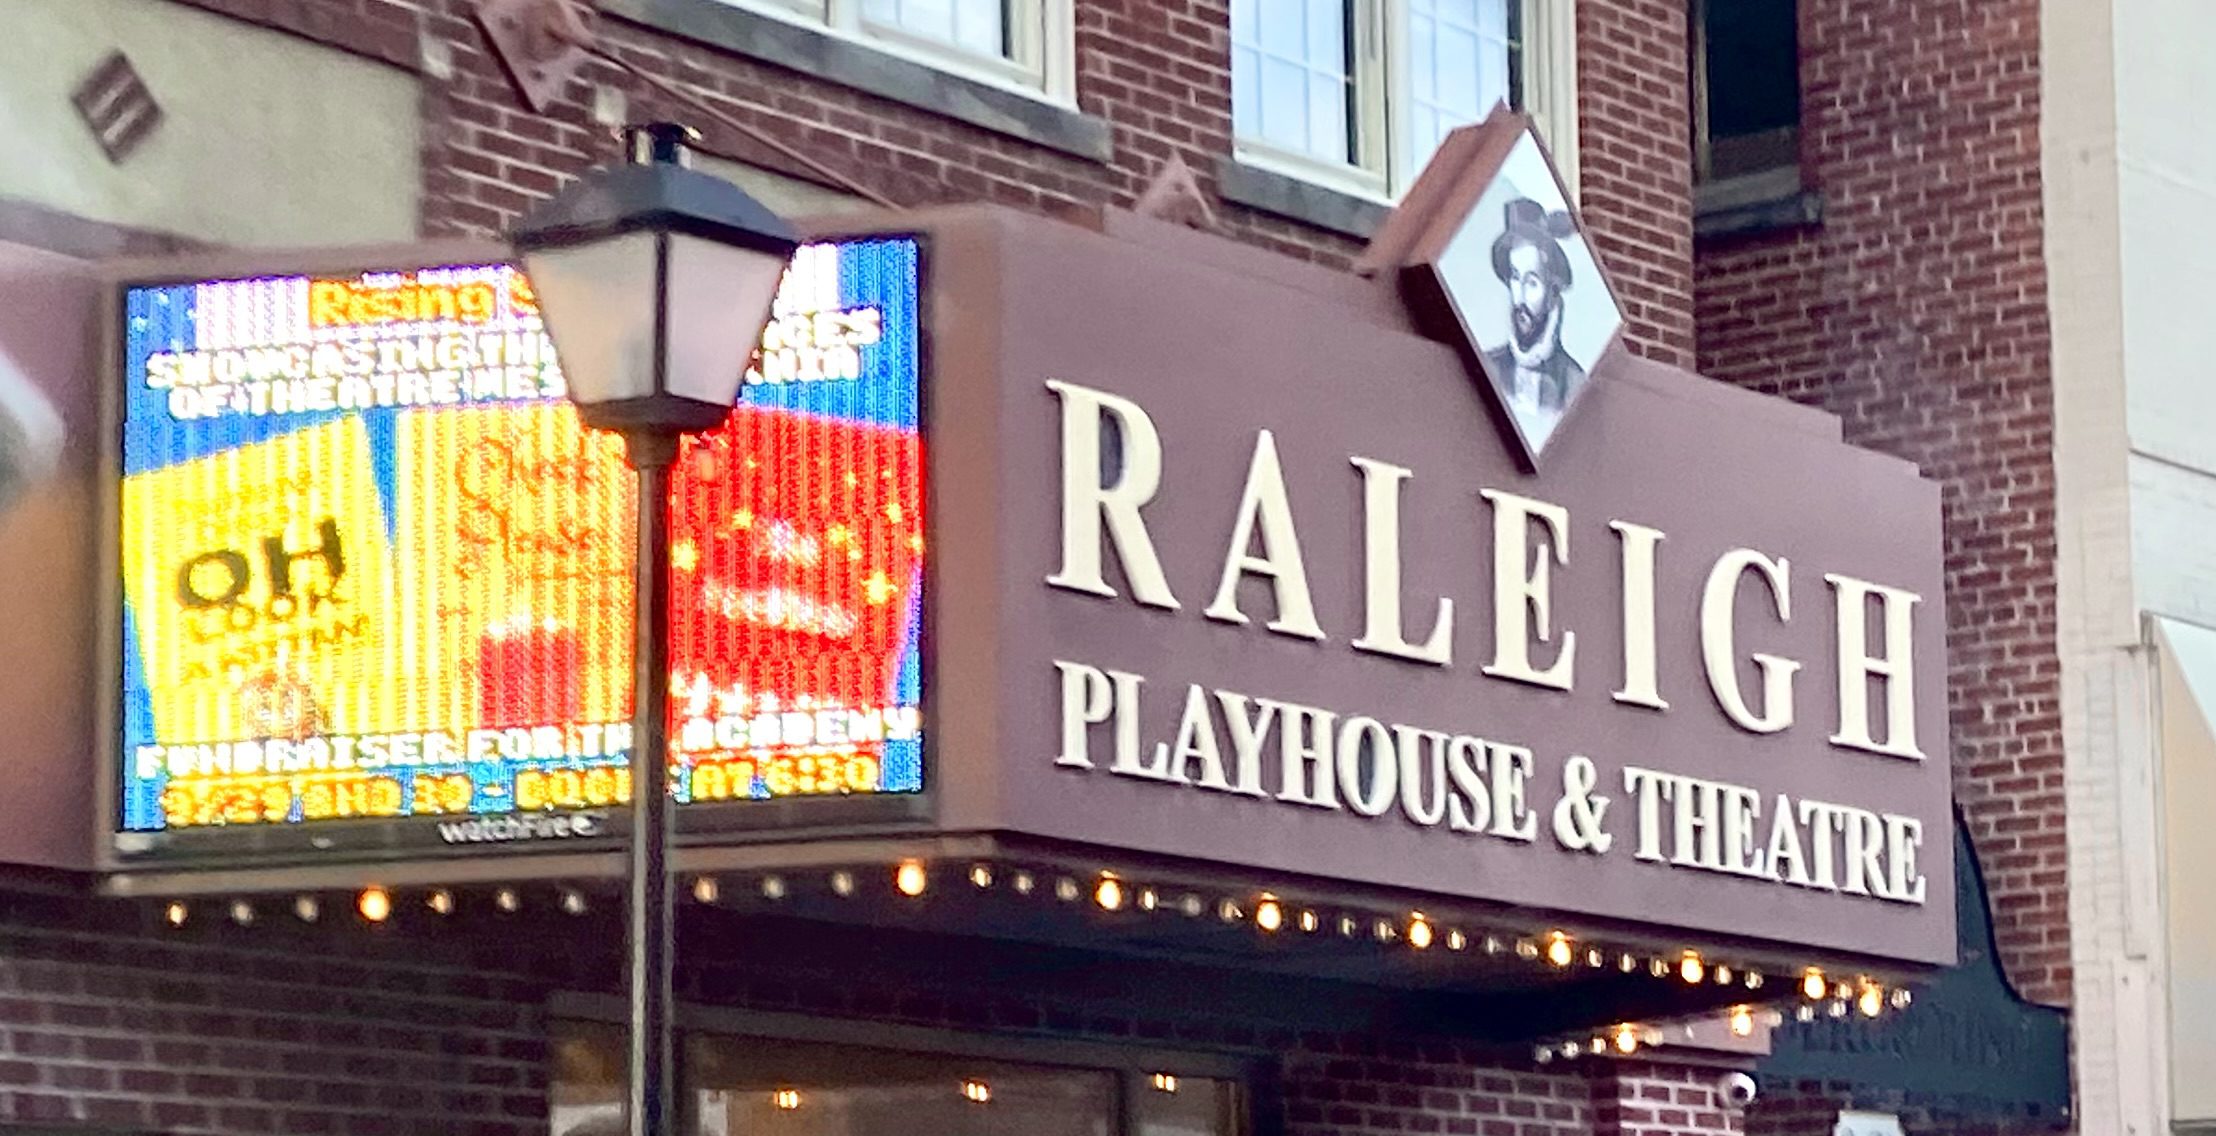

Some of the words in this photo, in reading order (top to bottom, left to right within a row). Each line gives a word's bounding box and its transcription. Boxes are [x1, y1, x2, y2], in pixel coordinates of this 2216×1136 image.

[310, 274, 496, 325] Rising
[168, 384, 228, 420] OF
[244, 367, 463, 417] THEATRE
[176, 516, 346, 608] OH
[1045, 378, 1927, 762] RALEIGH
[135, 730, 462, 780] FUNDRAISER
[466, 724, 565, 764] FOR
[576, 721, 633, 758] TH
[682, 705, 921, 751] ACADEMY
[300, 773, 402, 821] AND
[691, 760, 755, 801] AT
[762, 754, 881, 796] 6:30
[1052, 659, 1537, 842] PLAYHOUSE
[1552, 755, 1612, 853] &
[1623, 766, 1926, 904] THEATRE
